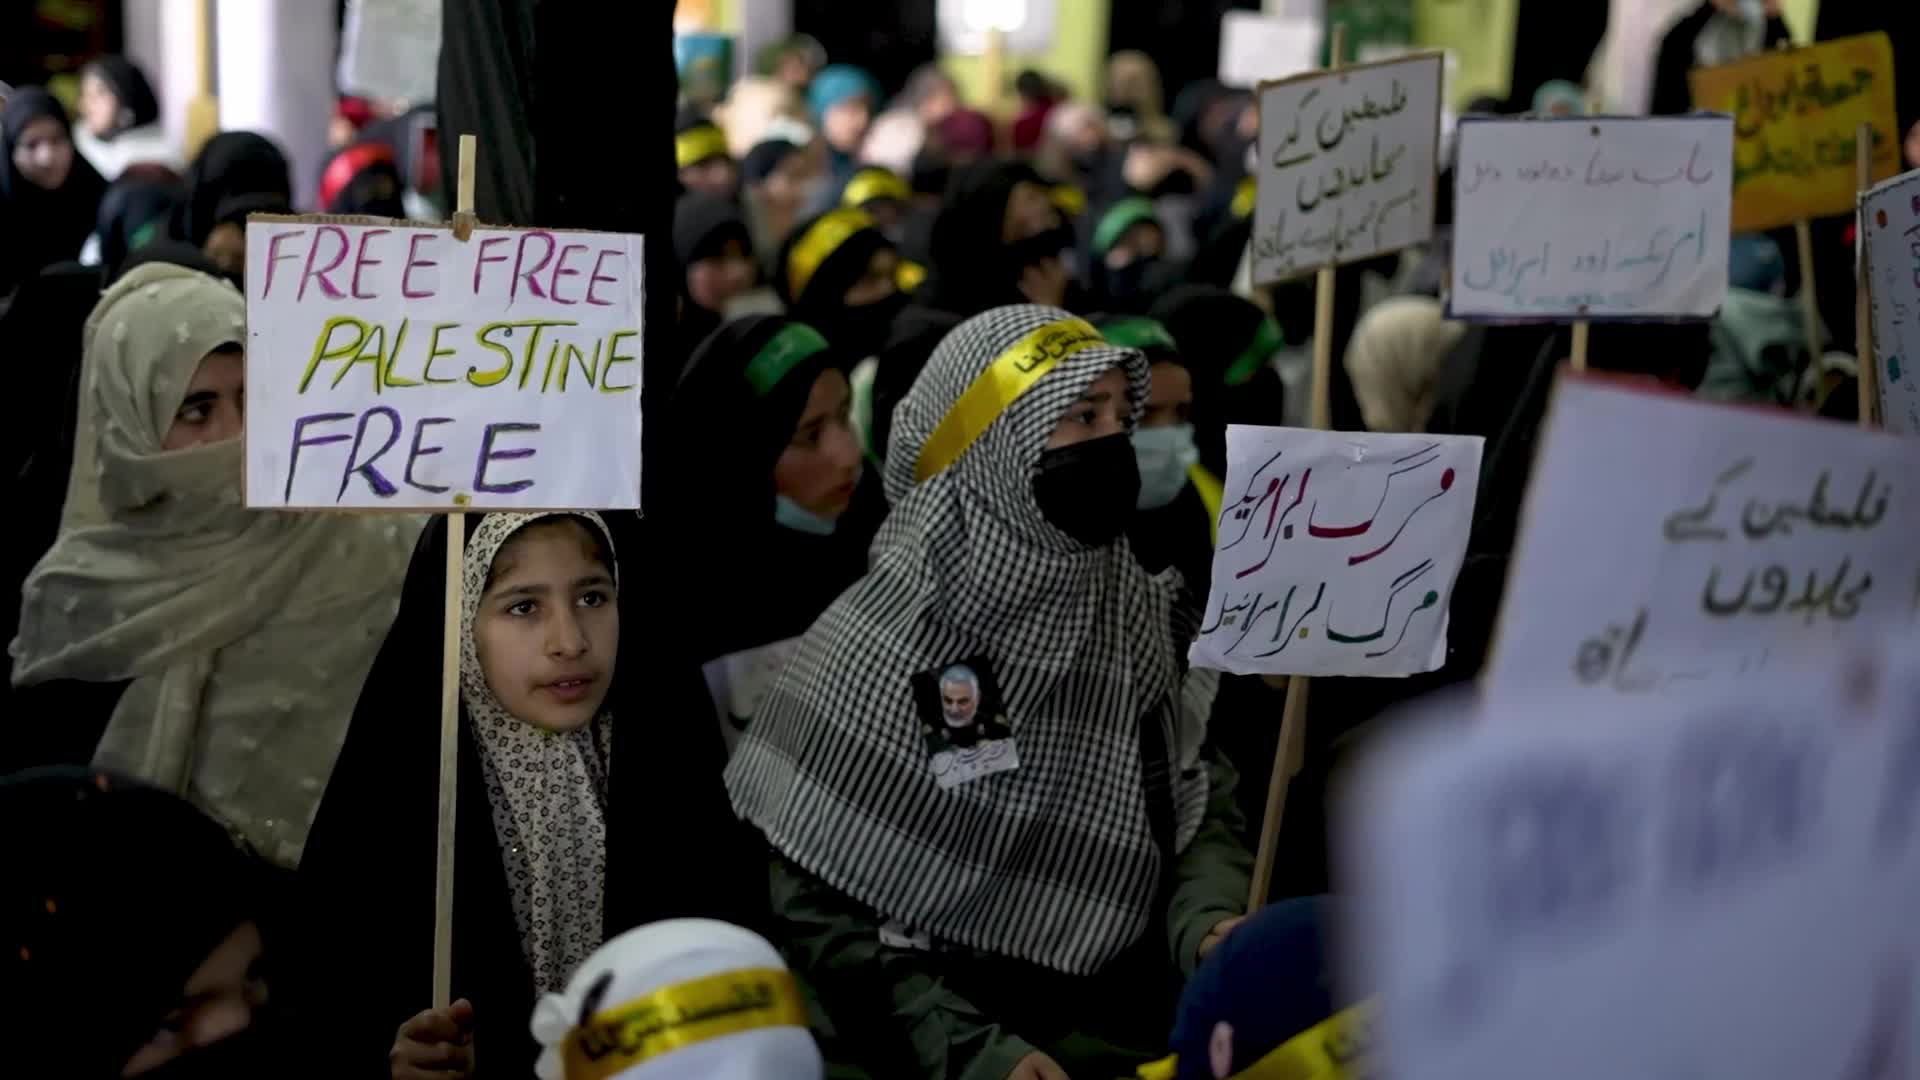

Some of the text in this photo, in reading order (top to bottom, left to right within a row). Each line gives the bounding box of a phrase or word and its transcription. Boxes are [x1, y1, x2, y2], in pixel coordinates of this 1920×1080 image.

[262, 225, 625, 308] FREE FREE
[284, 405, 541, 504] FREE
[1235, 466, 1311, 579] بر
[1308, 443, 1455, 567] مرگ
[1252, 581, 1326, 658] بر
[1326, 558, 1439, 658] مرگ
